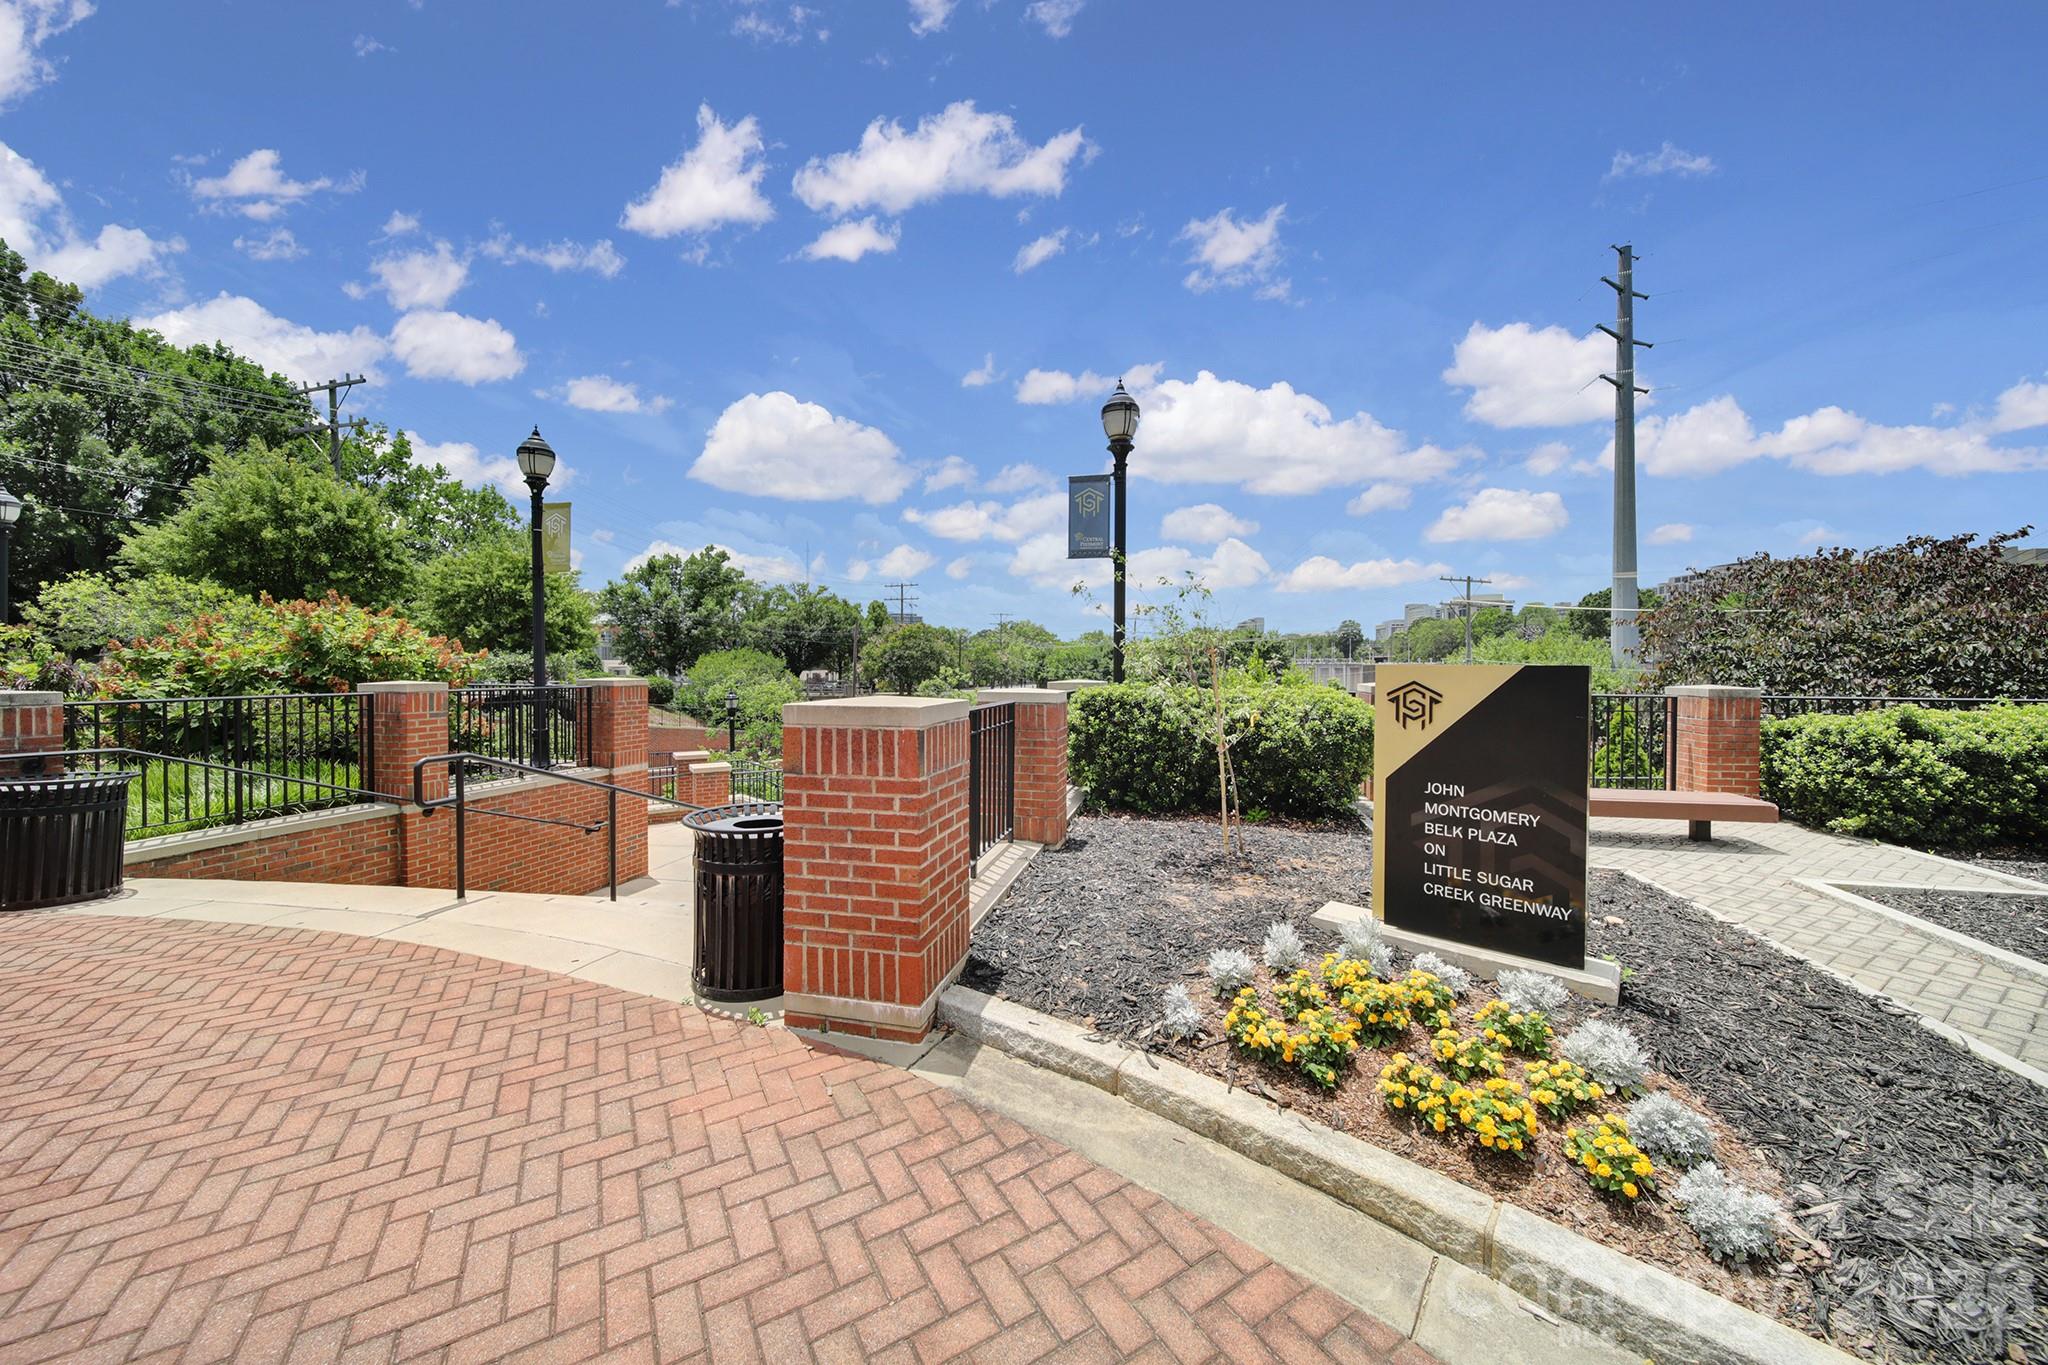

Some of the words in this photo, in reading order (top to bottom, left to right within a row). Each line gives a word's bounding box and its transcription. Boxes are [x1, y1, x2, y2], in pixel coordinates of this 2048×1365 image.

[1424, 782, 1465, 798] JOHN
[1424, 802, 1541, 828] MONTGOMERY
[1424, 822, 1464, 839] BELK
[1468, 828, 1518, 847] PLAZA
[1424, 843, 1446, 857] ON
[1424, 862, 1472, 882] LITTLE
[1477, 871, 1534, 893] SUGAR
[1423, 882, 1475, 903] CREEK
[1479, 893, 1573, 921] GREENWAY
